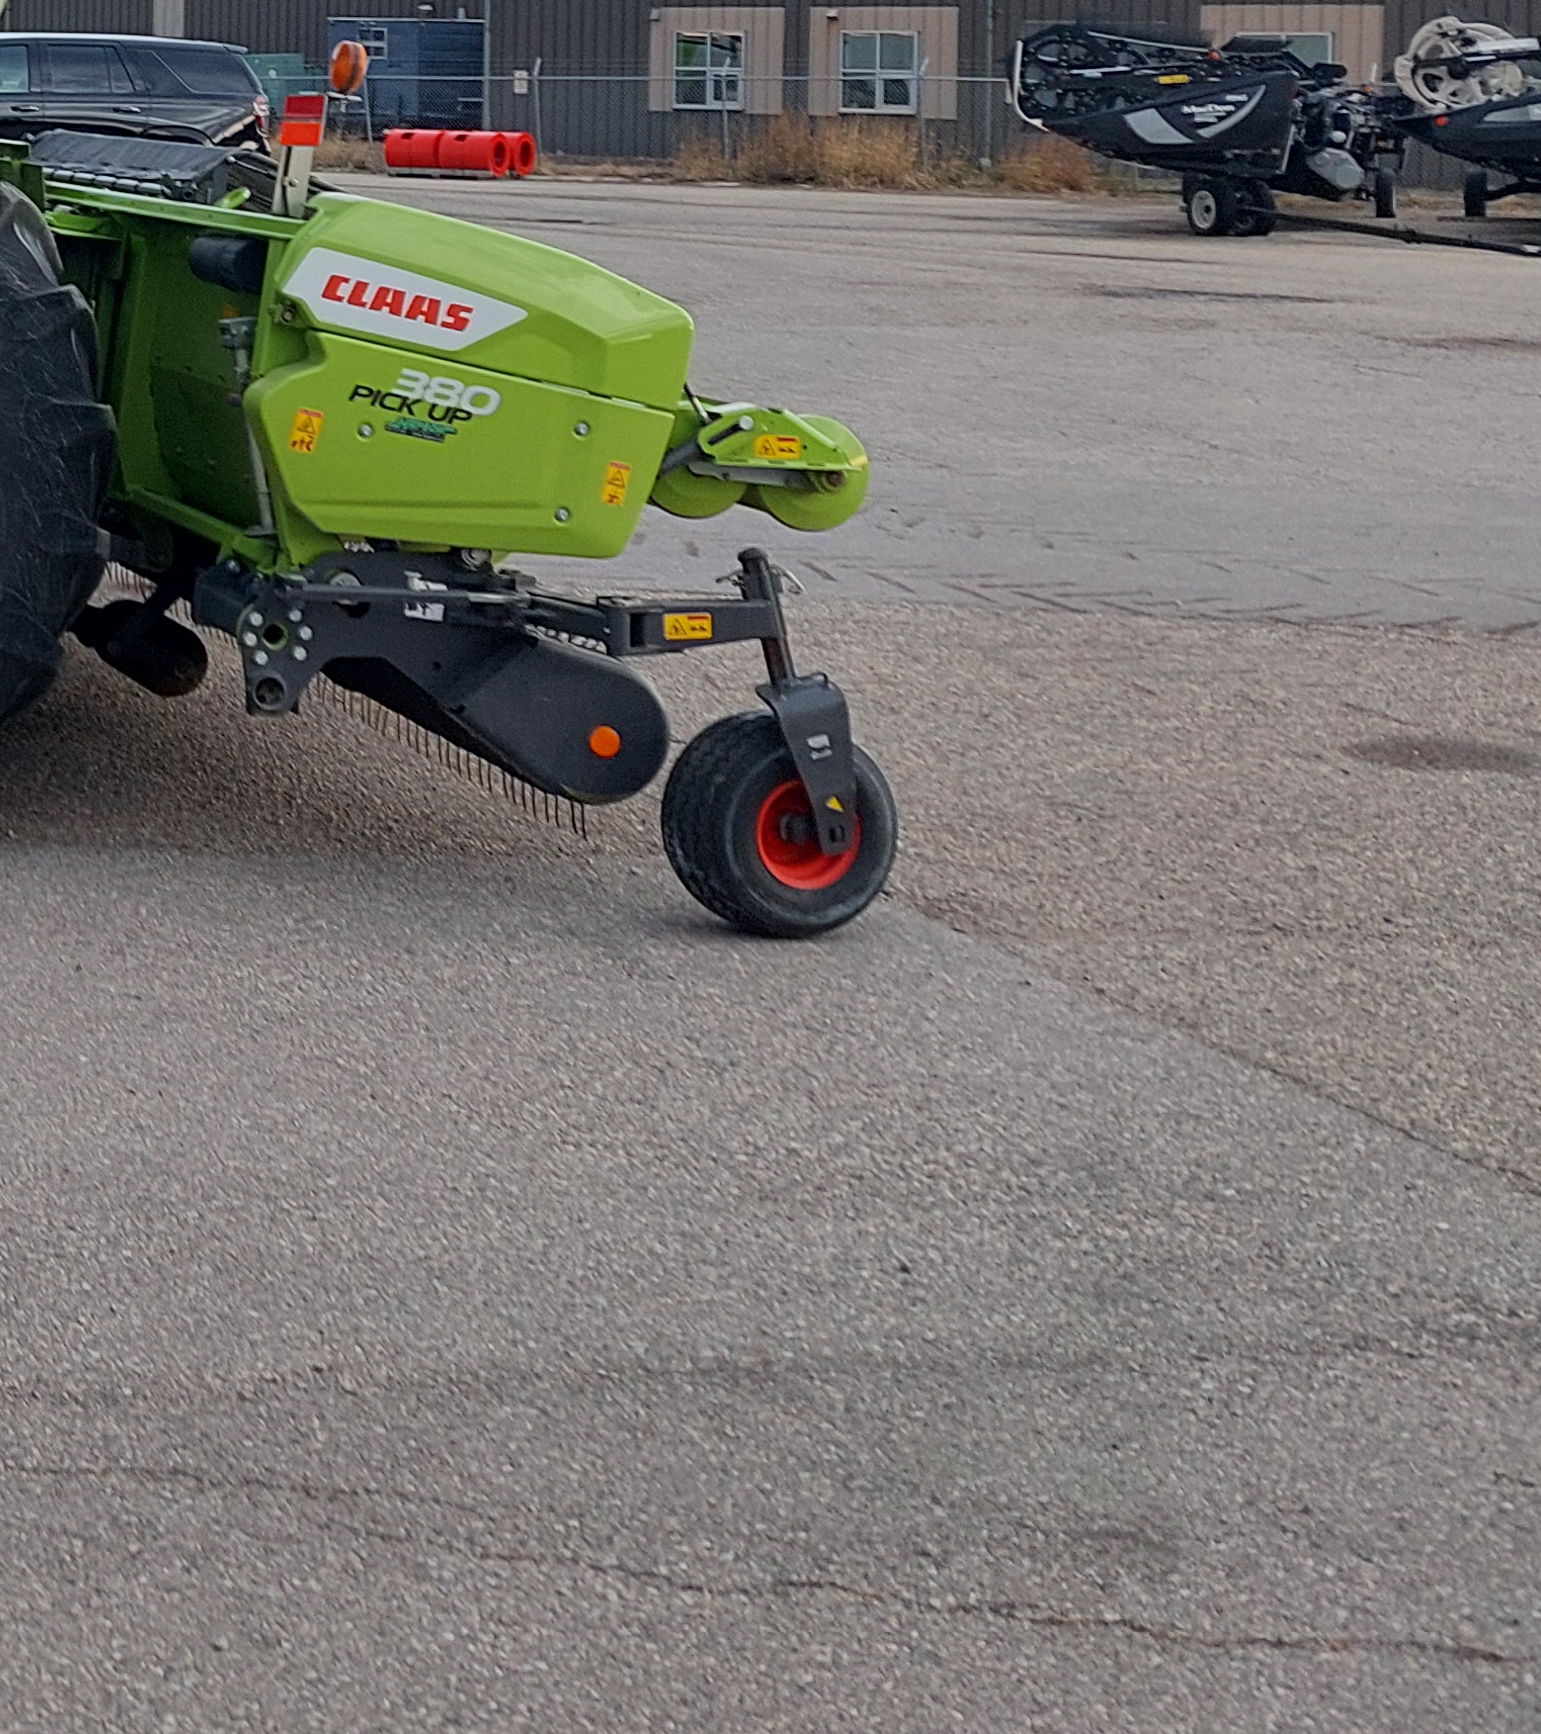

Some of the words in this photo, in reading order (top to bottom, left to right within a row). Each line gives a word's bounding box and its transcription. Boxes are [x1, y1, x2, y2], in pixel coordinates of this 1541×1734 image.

[322, 274, 474, 331] CLAAS
[349, 384, 421, 415] PICK
[427, 403, 475, 424] UP
[391, 368, 501, 416] 380
